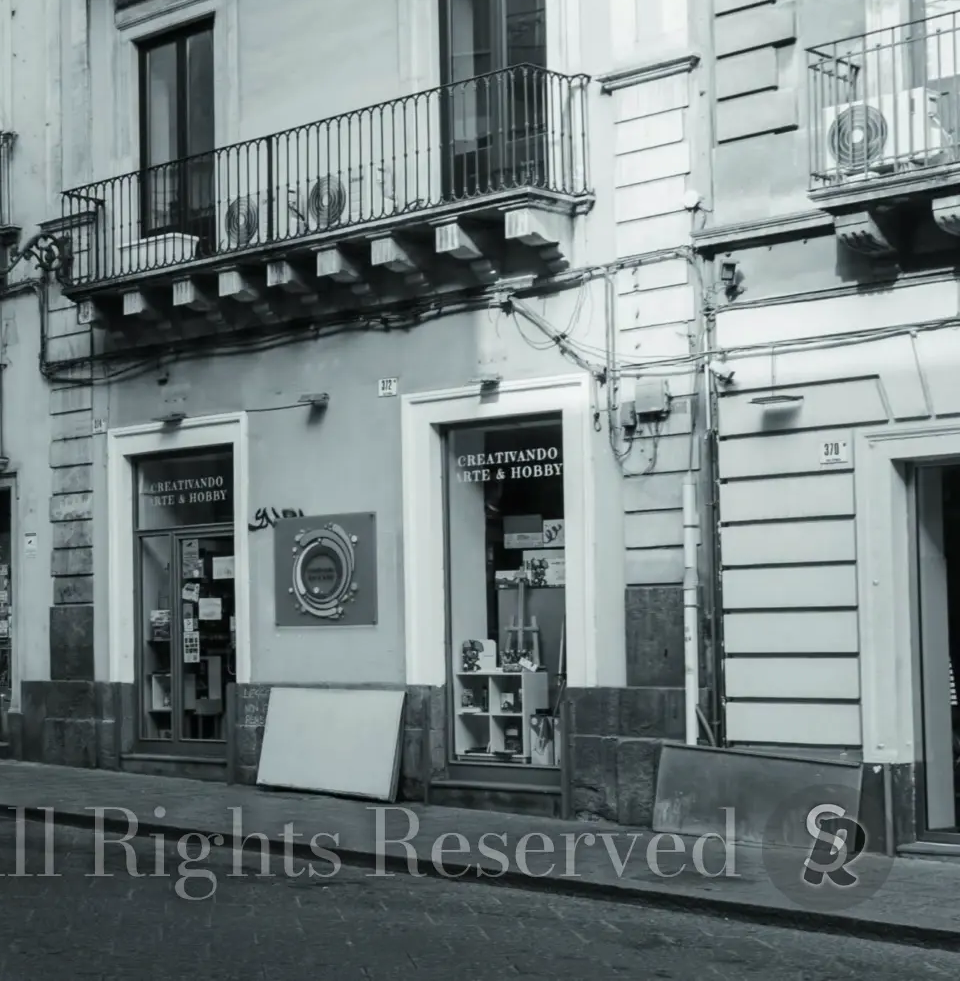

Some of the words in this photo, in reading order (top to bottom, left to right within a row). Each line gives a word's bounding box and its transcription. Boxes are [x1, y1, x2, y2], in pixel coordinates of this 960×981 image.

[457, 447, 558, 468] CREATIVANDO
[824, 442, 840, 456] 370
[495, 467, 506, 480] &
[510, 462, 564, 479] HOBBY
[150, 475, 224, 493] CREATIVANDO
[151, 494, 175, 506] RTE
[178, 493, 186, 504] &
[189, 489, 228, 504] HOBBY
